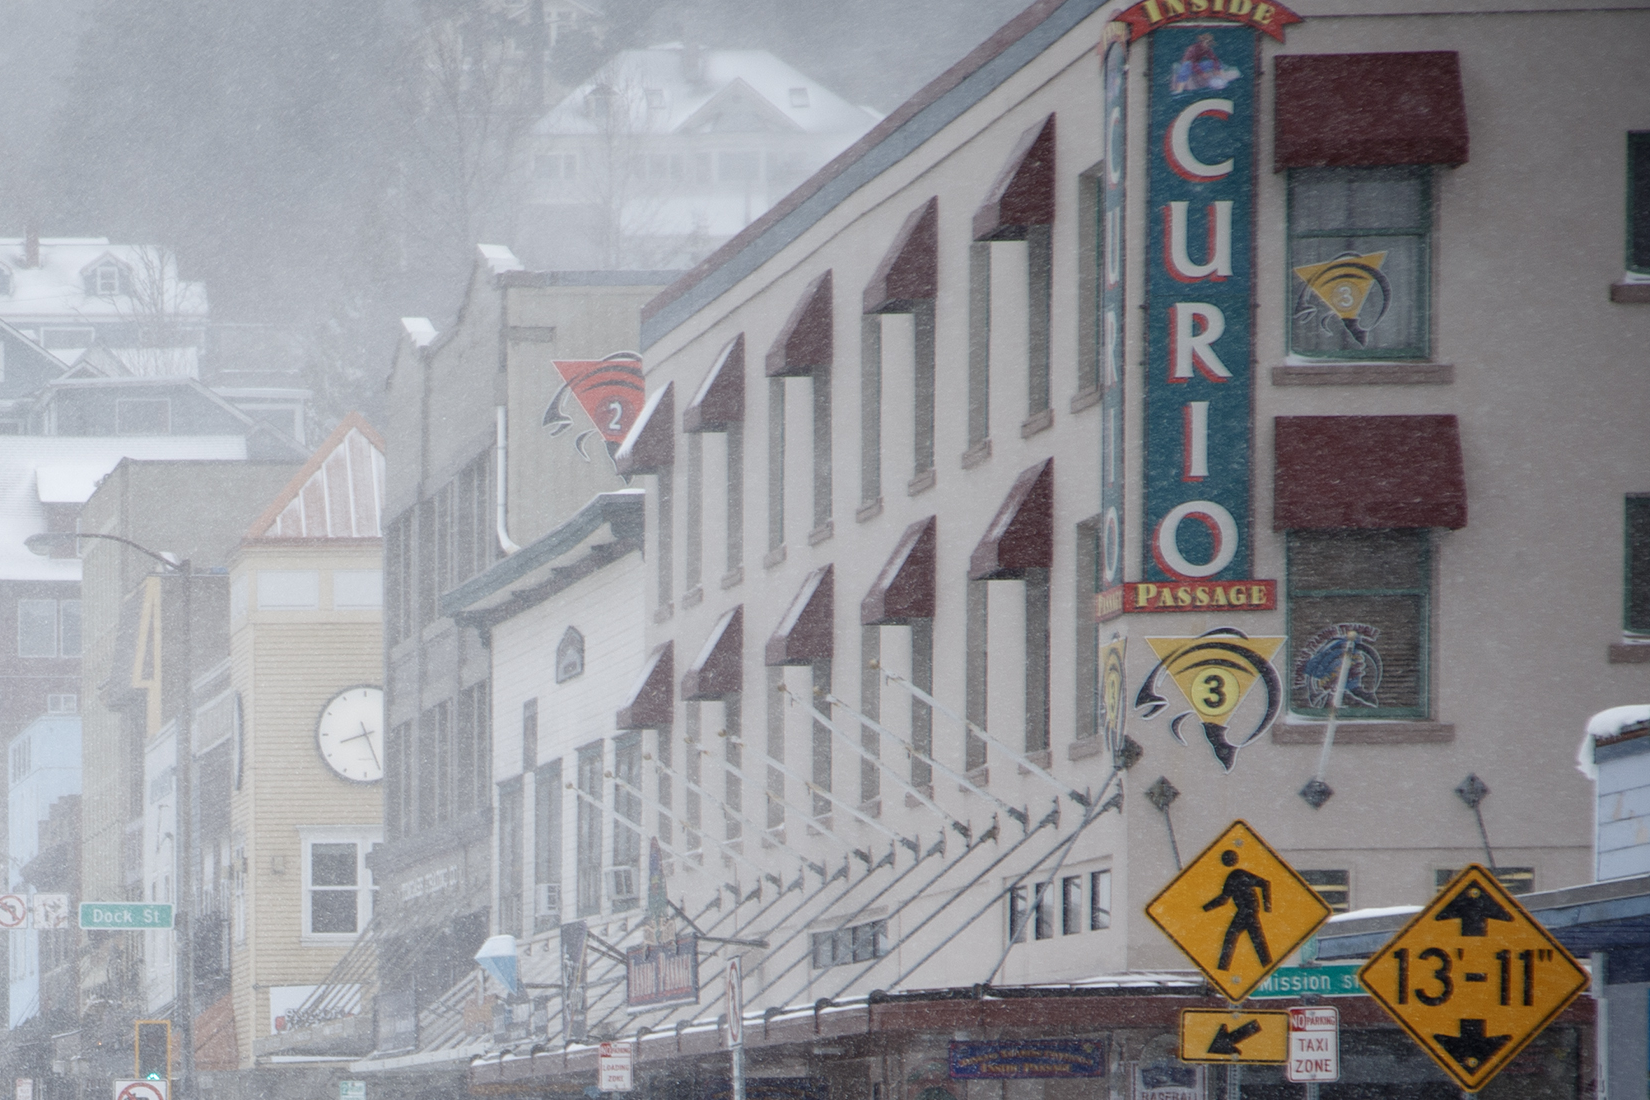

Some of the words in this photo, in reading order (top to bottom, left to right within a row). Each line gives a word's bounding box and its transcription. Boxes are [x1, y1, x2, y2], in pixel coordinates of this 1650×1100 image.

[1339, 286, 1354, 307] 3
[1157, 98, 1239, 578] CURIO
[609, 402, 623, 430] 2
[1137, 583, 1267, 606] PASSAGE
[1203, 674, 1227, 708] 3
[93, 909, 132, 923] Dock
[143, 909, 161, 924] St
[1258, 974, 1331, 992] Mission
[1292, 1014, 1306, 1028] NO
[1307, 1015, 1336, 1026] PARKING
[1298, 1038, 1329, 1052] TAXI
[1295, 1059, 1332, 1073] ZONE
